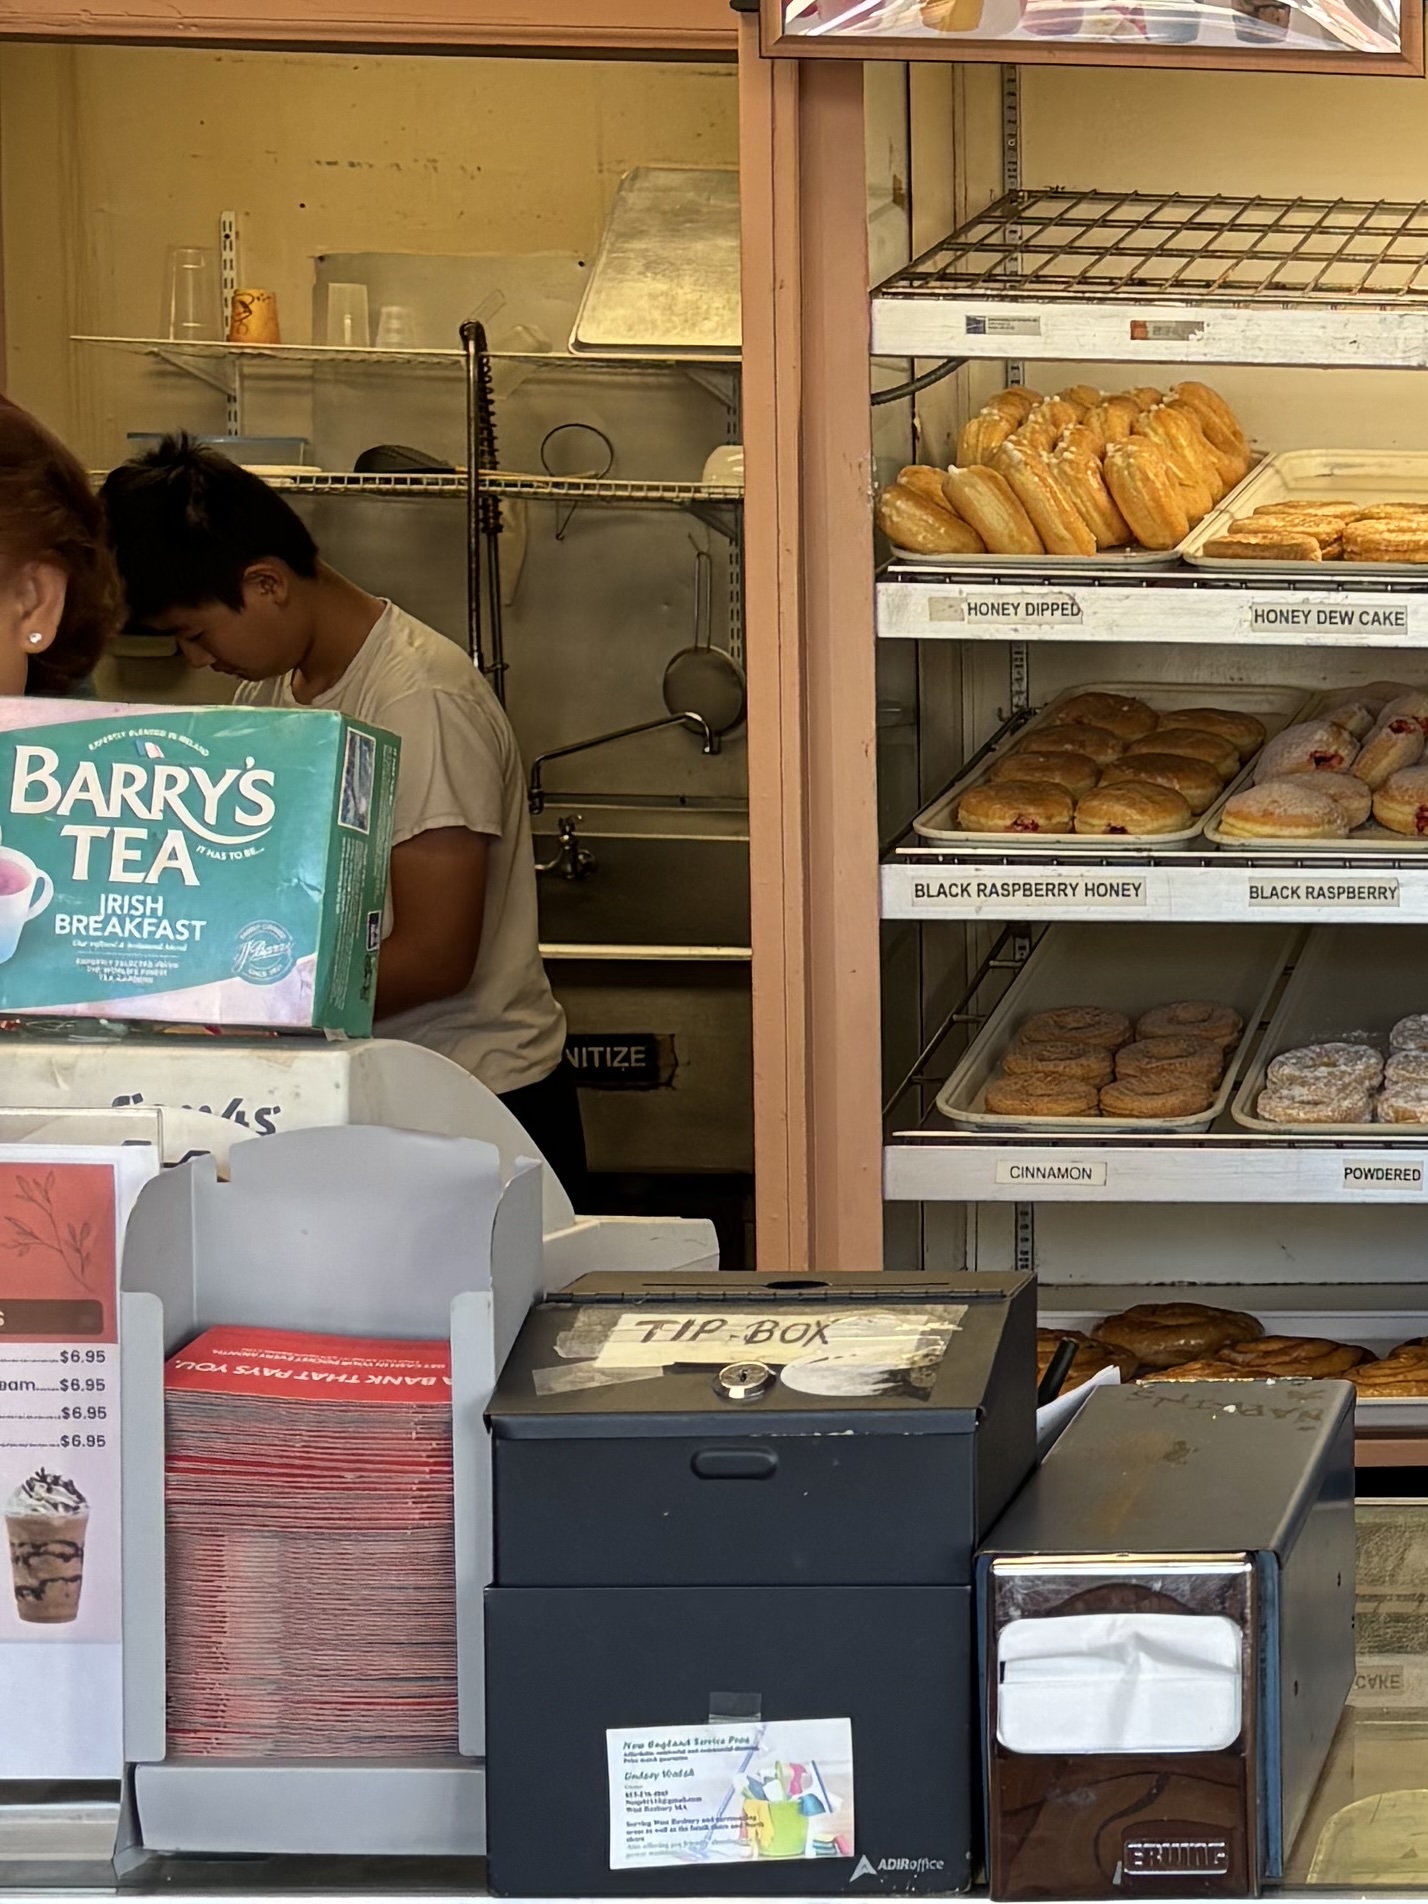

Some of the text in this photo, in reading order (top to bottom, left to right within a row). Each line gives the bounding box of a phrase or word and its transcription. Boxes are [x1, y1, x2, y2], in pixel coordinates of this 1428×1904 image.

[967, 601, 1081, 617] HONEY DIPPED
[1254, 608, 1406, 626] HONEY DEW CAKE
[9, 745, 277, 844] BARRY'S
[60, 825, 201, 886] TEA
[914, 882, 1142, 899] BLACK RASPBERRY HONEY
[1249, 885, 1398, 901] BLACK RASPBERRY
[98, 894, 163, 918] IRISH
[54, 915, 207, 942] BREAKFAST
[1010, 1166, 1092, 1180] CINNAMON
[1344, 1167, 1421, 1181] POWDERED
[174, 1359, 227, 1373] YOU.
[233, 1363, 282, 1378] PAYS
[293, 1369, 360, 1384] THAT
[362, 1375, 434, 1386] BANK
[878, 1858, 945, 1872] ADIRoffice
